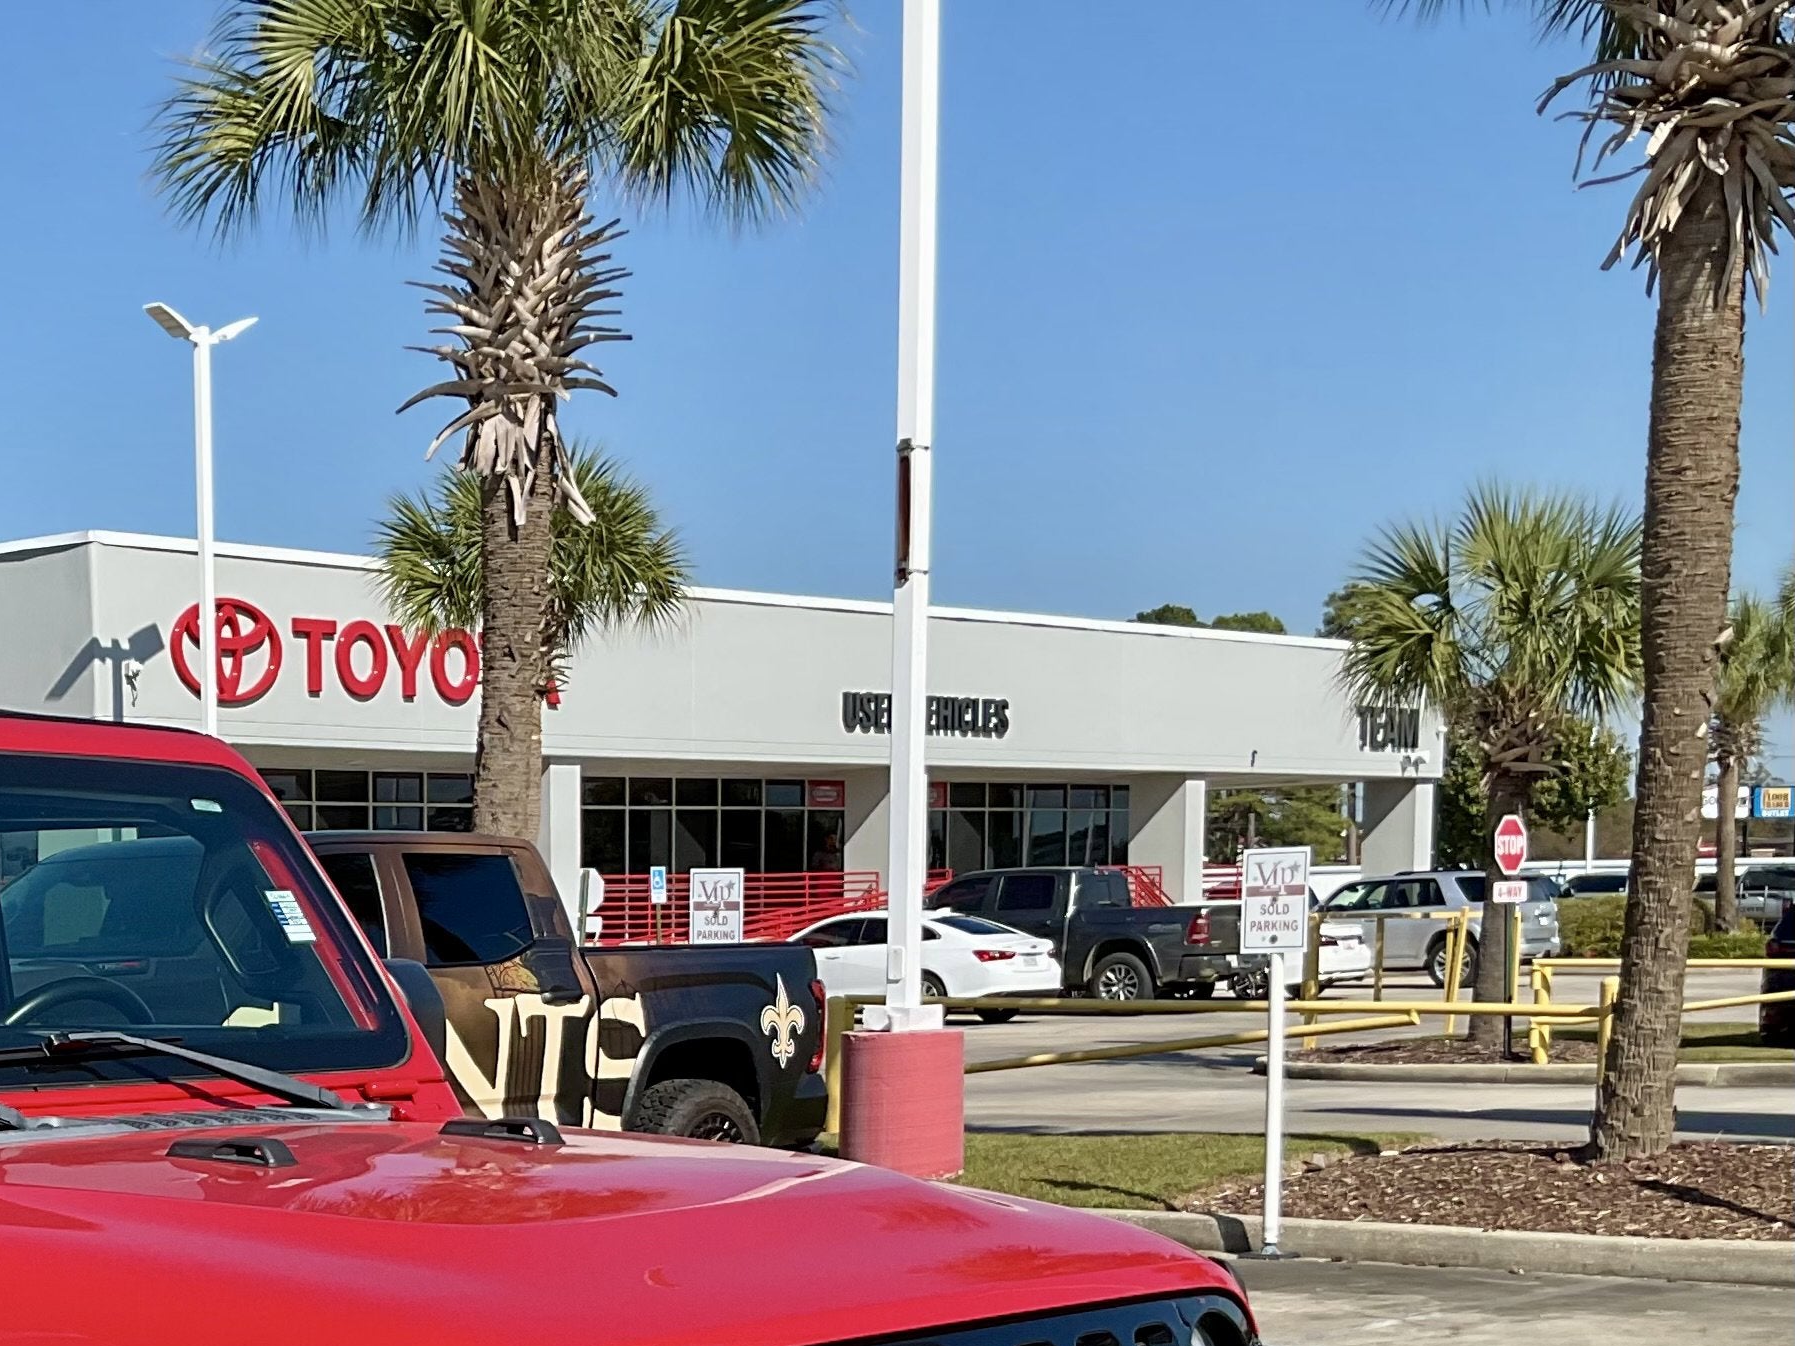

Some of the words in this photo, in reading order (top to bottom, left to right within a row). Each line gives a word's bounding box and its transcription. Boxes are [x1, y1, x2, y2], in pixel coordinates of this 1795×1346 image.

[291, 617, 560, 710] TOYO
[925, 695, 1010, 739] EHICLES
[1356, 705, 1420, 752] TEAM
[1497, 835, 1524, 855] STOP
[1259, 903, 1290, 916] SOLD
[704, 915, 728, 926] SOLD
[1250, 920, 1299, 932] PARKING
[697, 930, 735, 940] PARKING
